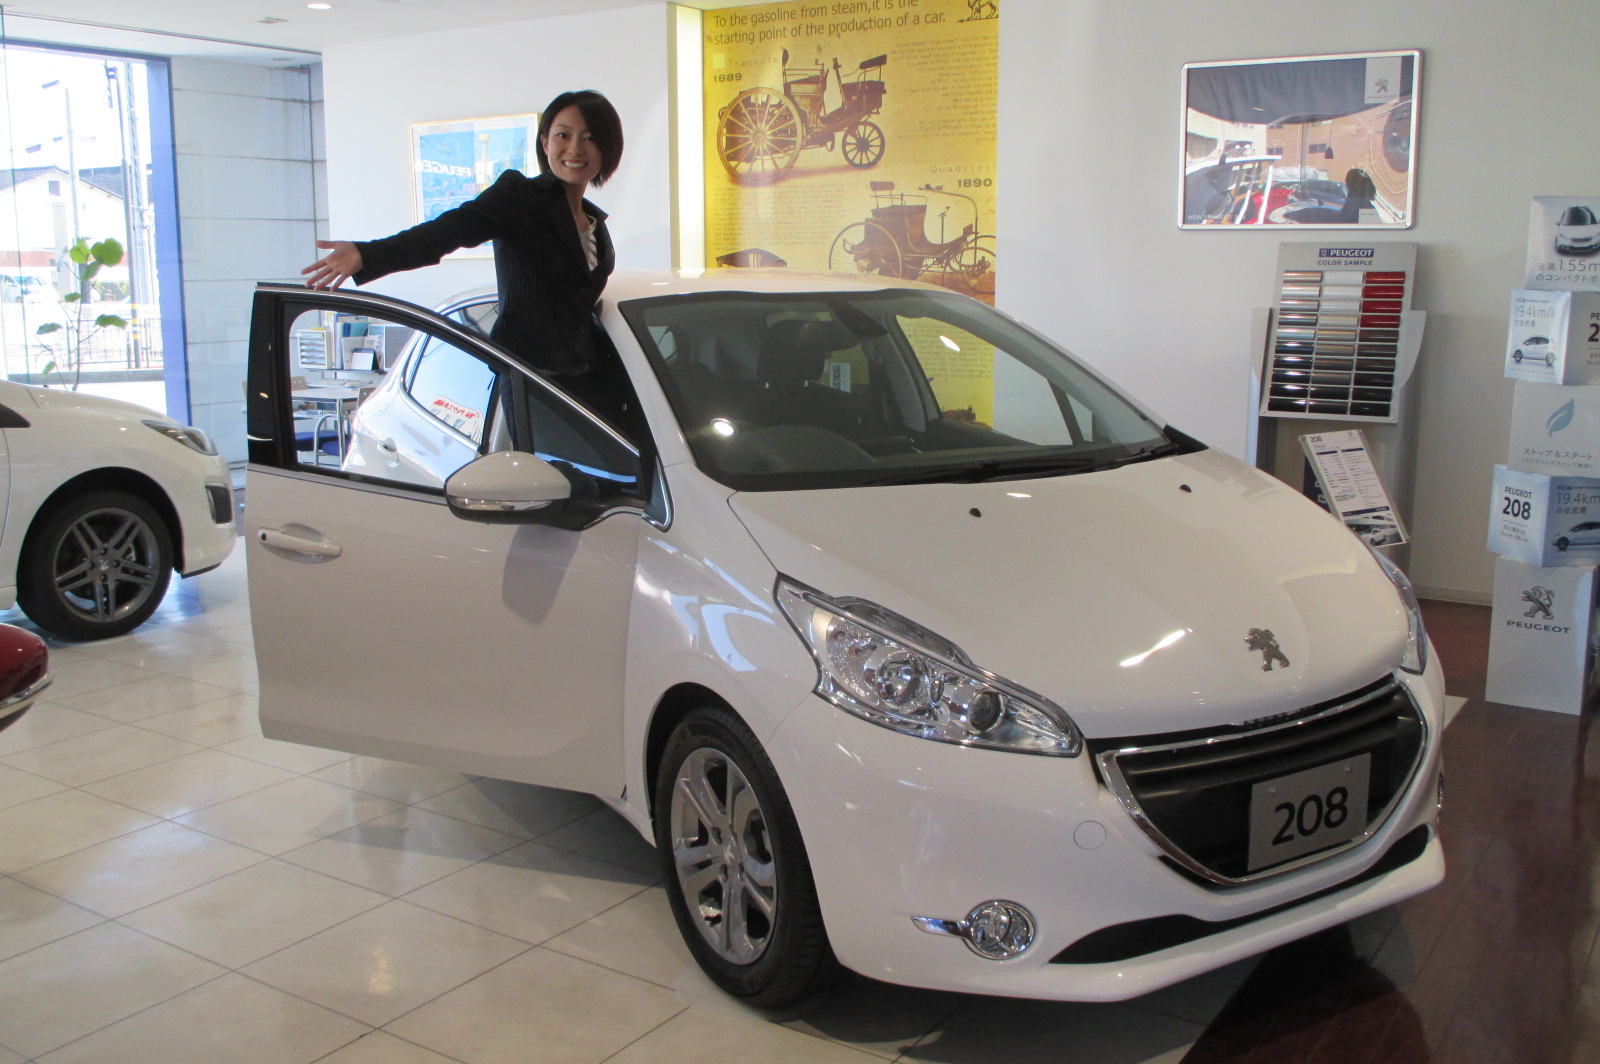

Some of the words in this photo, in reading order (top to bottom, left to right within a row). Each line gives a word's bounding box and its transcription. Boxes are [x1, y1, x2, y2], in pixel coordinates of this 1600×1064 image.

[714, 15, 727, 28] To
[730, 14, 748, 26] the
[750, 8, 797, 27] gasoline
[801, 5, 828, 18] from
[714, 30, 755, 45] starting
[759, 25, 788, 43] point
[790, 23, 803, 37] of
[806, 22, 825, 36] the
[828, 16, 891, 37] production
[896, 12, 909, 27] of
[912, 16, 920, 25] a
[924, 12, 946, 24] car.
[712, 72, 743, 83] 1889
[957, 178, 993, 188] 1890
[1330, 249, 1373, 257] PEUGEOT
[1309, 435, 1323, 443] 208
[1504, 486, 1533, 499] PEUGEOT
[1502, 496, 1531, 521] 208
[1507, 619, 1570, 634] PEUGEOT
[1272, 786, 1349, 846] 208
